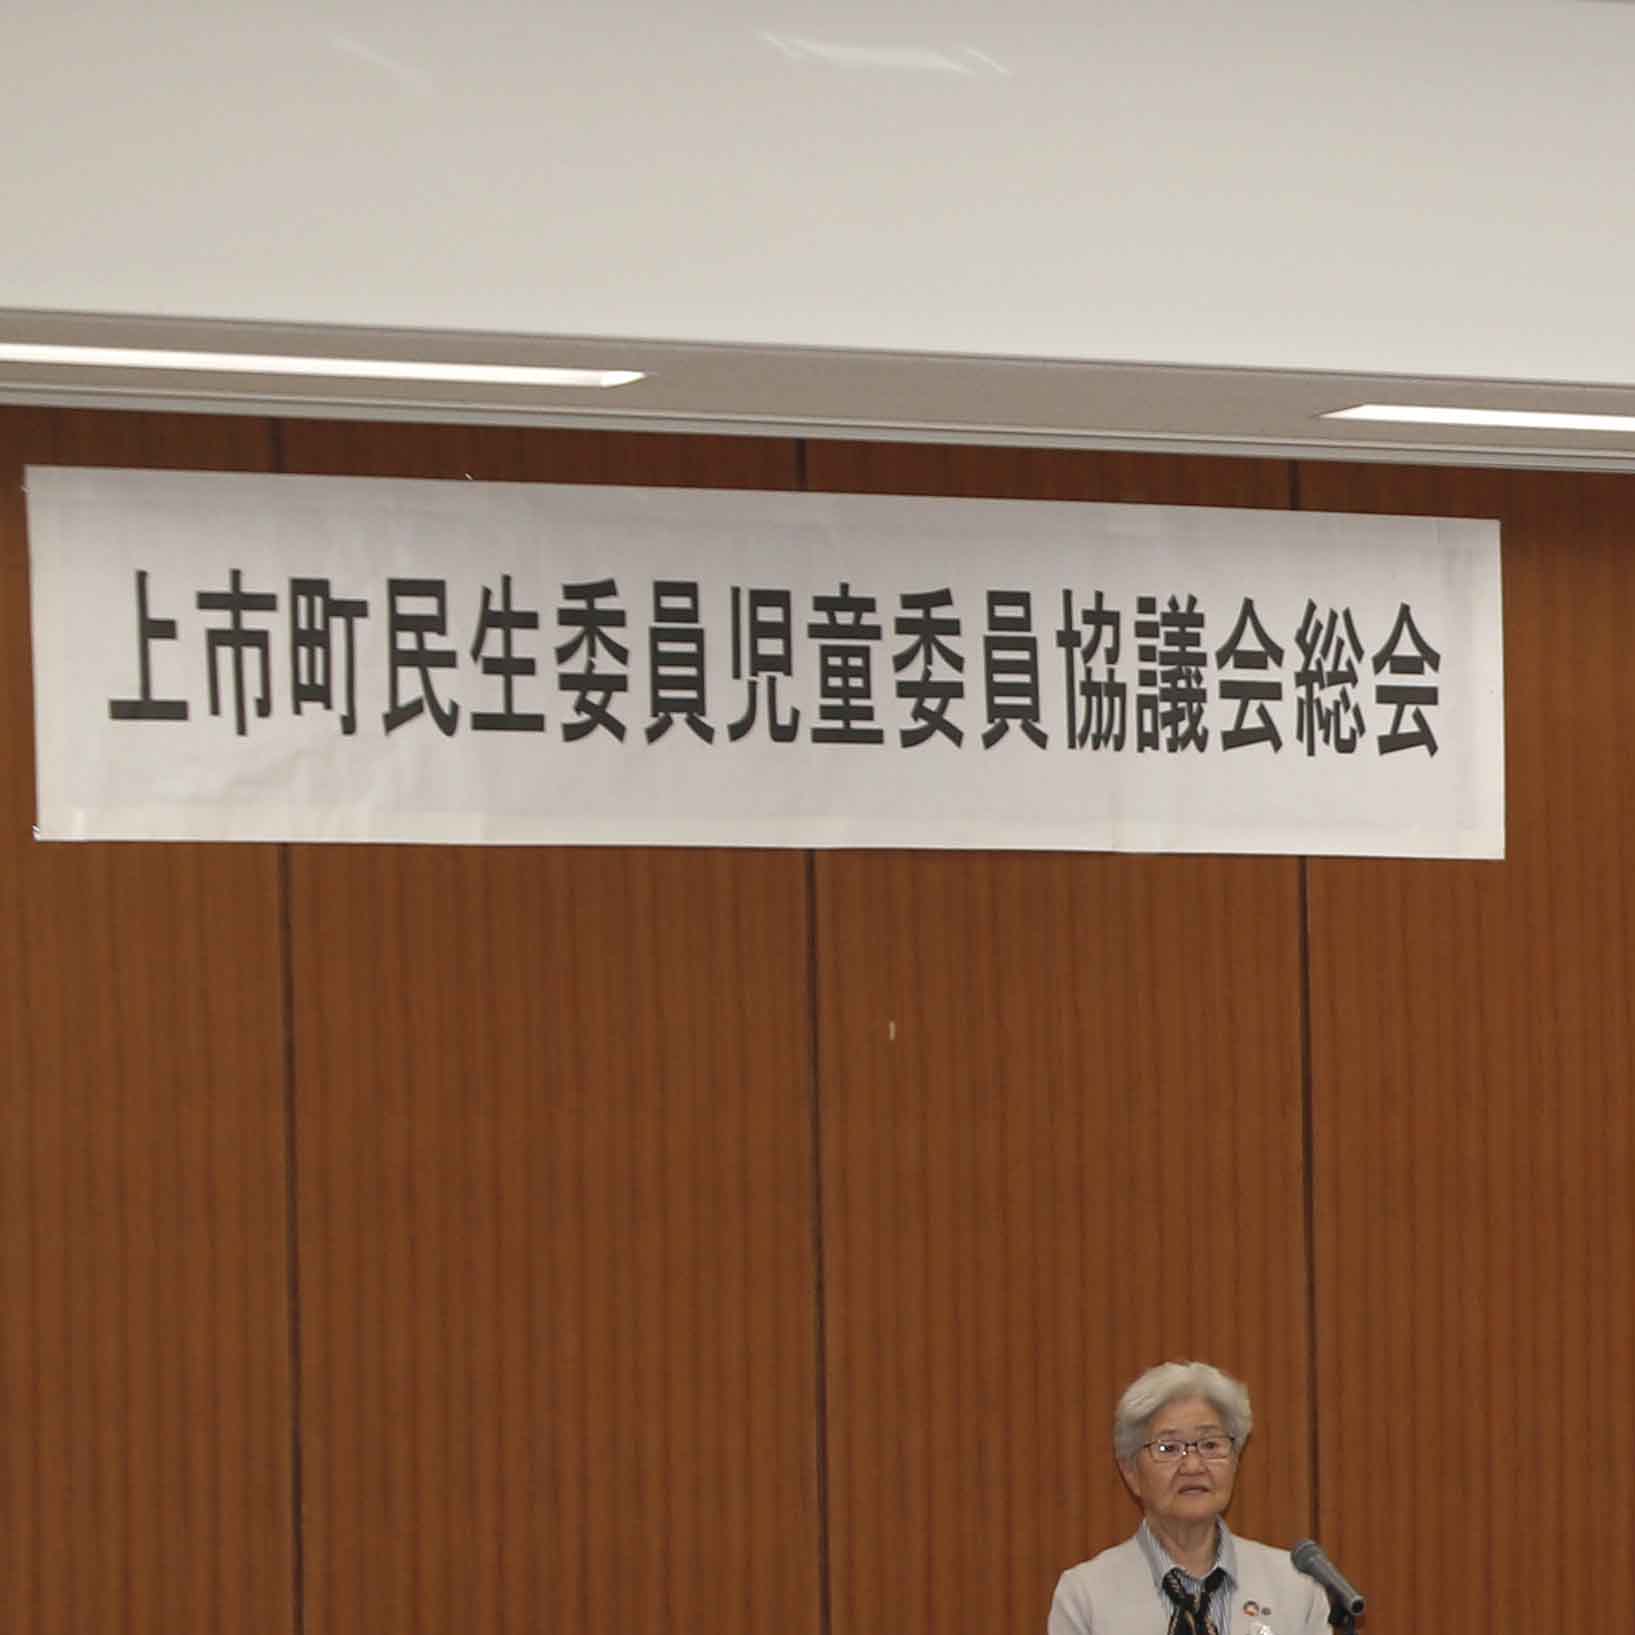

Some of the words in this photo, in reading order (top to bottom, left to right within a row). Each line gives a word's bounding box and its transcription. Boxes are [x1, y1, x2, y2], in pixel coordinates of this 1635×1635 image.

[109, 568, 1441, 757] 上市町民生委員児童委員協議会総会
